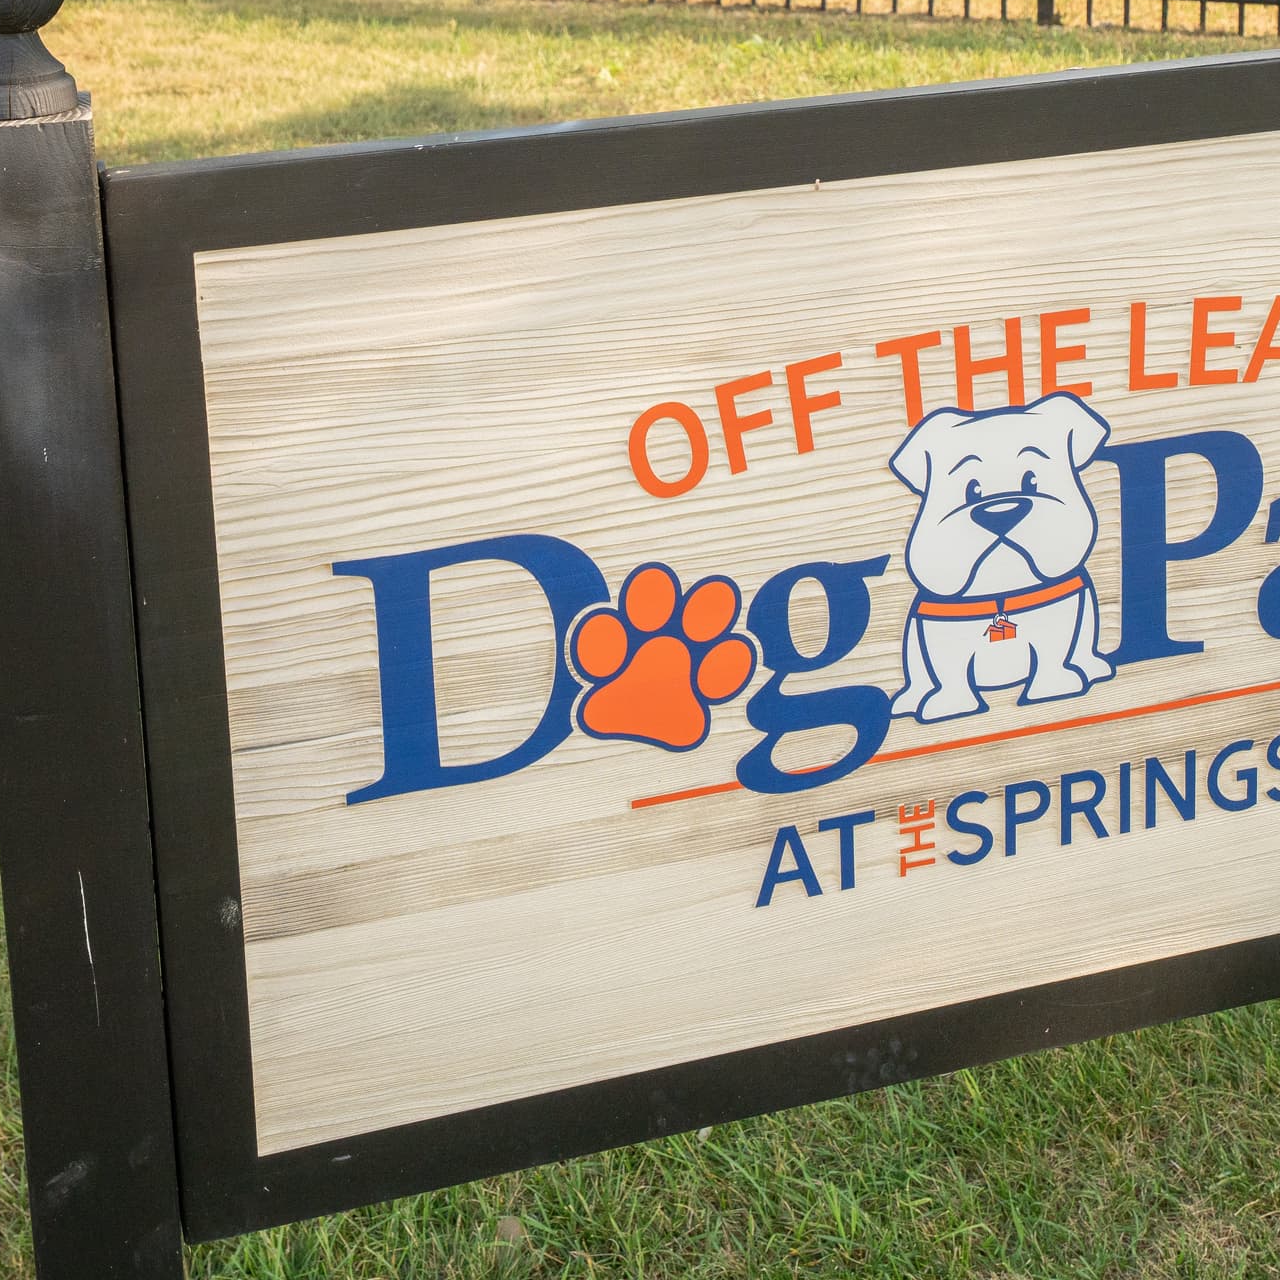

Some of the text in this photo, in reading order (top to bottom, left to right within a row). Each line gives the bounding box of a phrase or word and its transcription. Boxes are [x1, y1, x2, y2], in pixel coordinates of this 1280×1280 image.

[627, 351, 843, 500] OFF
[874, 306, 1094, 428] THE
[331, 533, 893, 805] Dg
[756, 810, 877, 908] AT
[897, 798, 937, 878] THE
